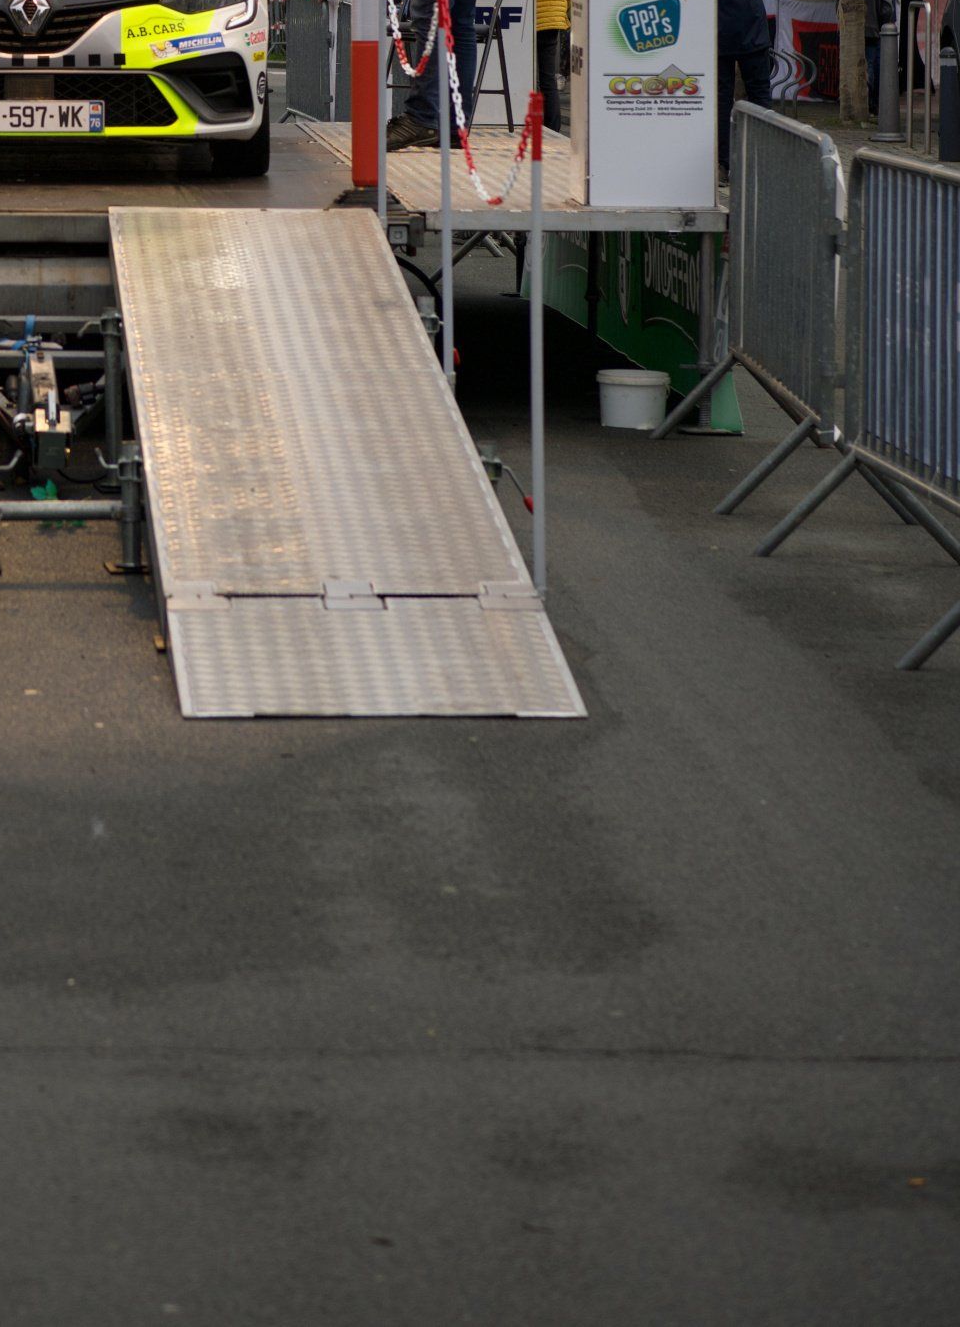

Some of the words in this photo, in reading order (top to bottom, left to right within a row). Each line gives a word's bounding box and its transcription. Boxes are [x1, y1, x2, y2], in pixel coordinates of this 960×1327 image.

[126, 26, 152, 39] A.B.
[153, 23, 185, 35] CARS
[179, 36, 223, 49] MICHELIN
[636, 35, 675, 52] RADIO
[90, 118, 101, 128] 76
